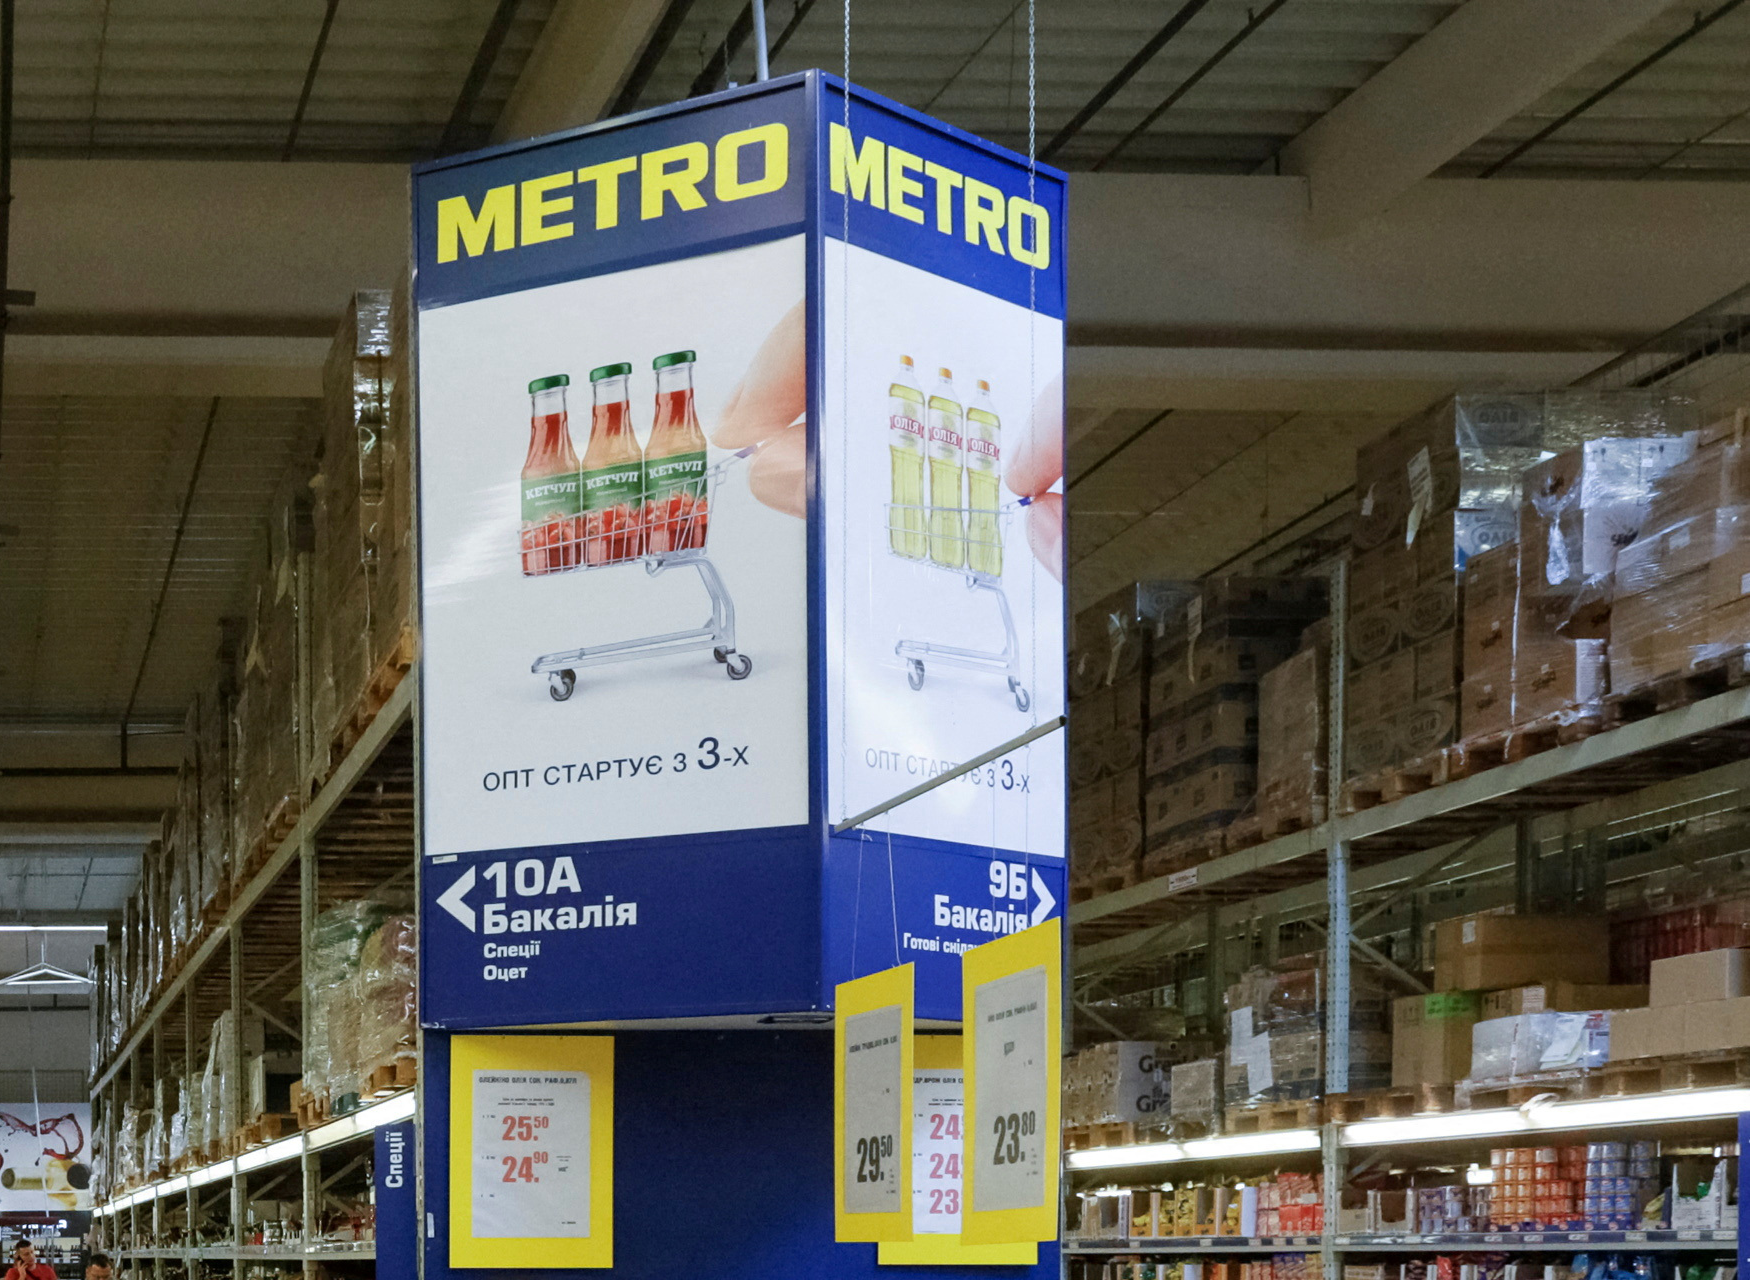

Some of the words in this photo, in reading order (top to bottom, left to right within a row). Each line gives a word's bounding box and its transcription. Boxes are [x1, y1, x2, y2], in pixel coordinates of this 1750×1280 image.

[436, 122, 789, 265] METRO
[828, 121, 1051, 270] METRO
[893, 416, 920, 434] ОЛІЯ
[933, 428, 958, 445] ОЛІЯ
[971, 439, 995, 456] ОЛІЯ
[585, 471, 639, 490] КЕТЧУП
[648, 460, 703, 480] КЕТЧУП
[525, 482, 577, 500] КЕТЧУП
[865, 747, 901, 773] ОПТ
[483, 768, 535, 792] ОПТ
[543, 755, 663, 786] СТАРТУЄ
[482, 855, 583, 899] 10А
[988, 859, 1028, 901] 9Б
[483, 894, 638, 935] Бакалія
[933, 893, 1028, 935] Бакалія
[483, 939, 542, 960] Спеції
[903, 932, 940, 953] Готові
[483, 964, 529, 983] Оцет
[384, 1130, 406, 1188] Спеції
